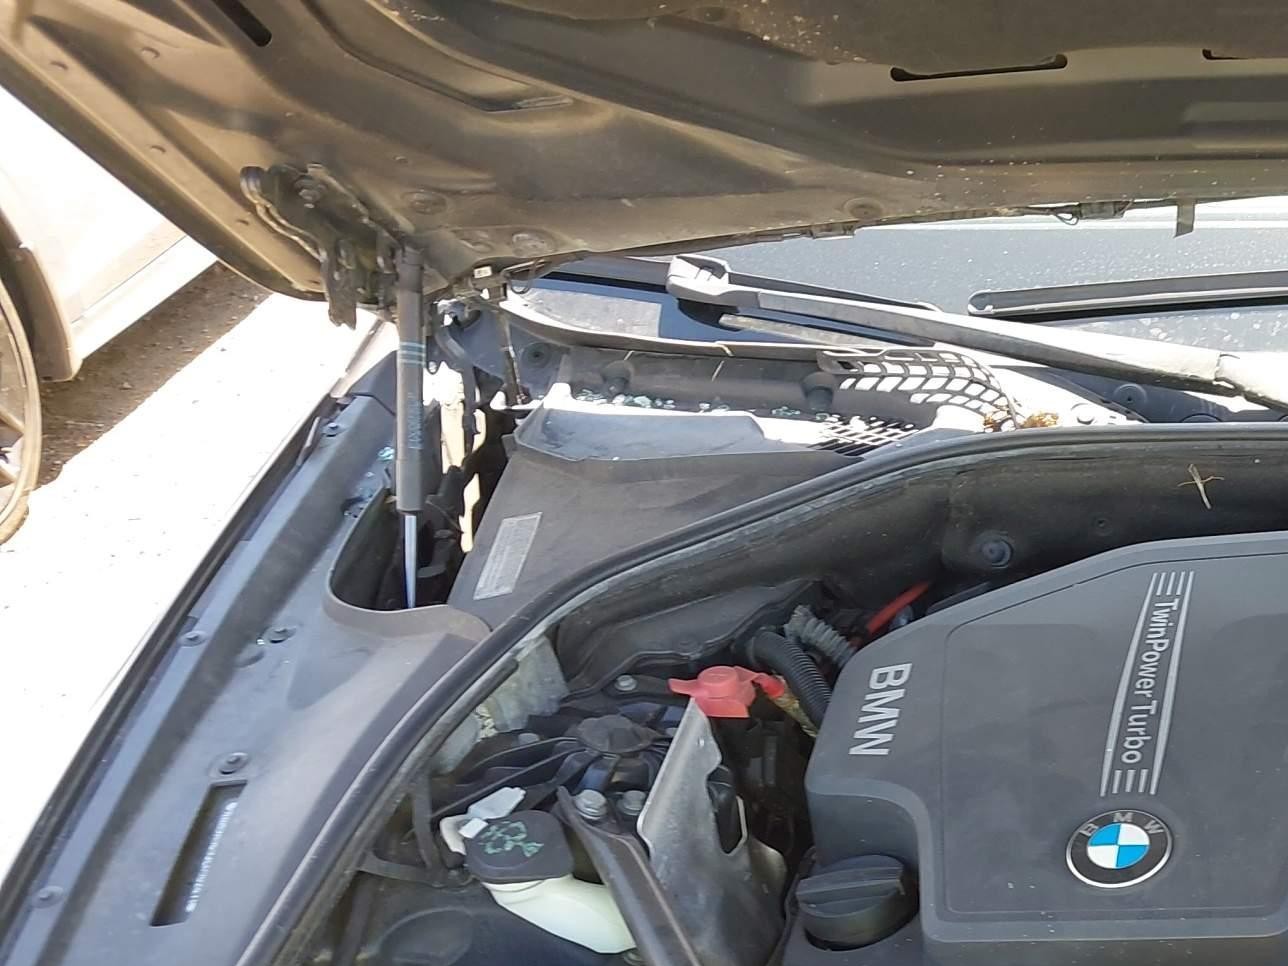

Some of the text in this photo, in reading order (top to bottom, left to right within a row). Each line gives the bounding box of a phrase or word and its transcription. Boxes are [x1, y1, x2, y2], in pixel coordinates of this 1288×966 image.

[848, 663, 912, 755] BMW
[1120, 598, 1180, 763] TwinPower Turbo
[1079, 812, 1165, 837] BMW
